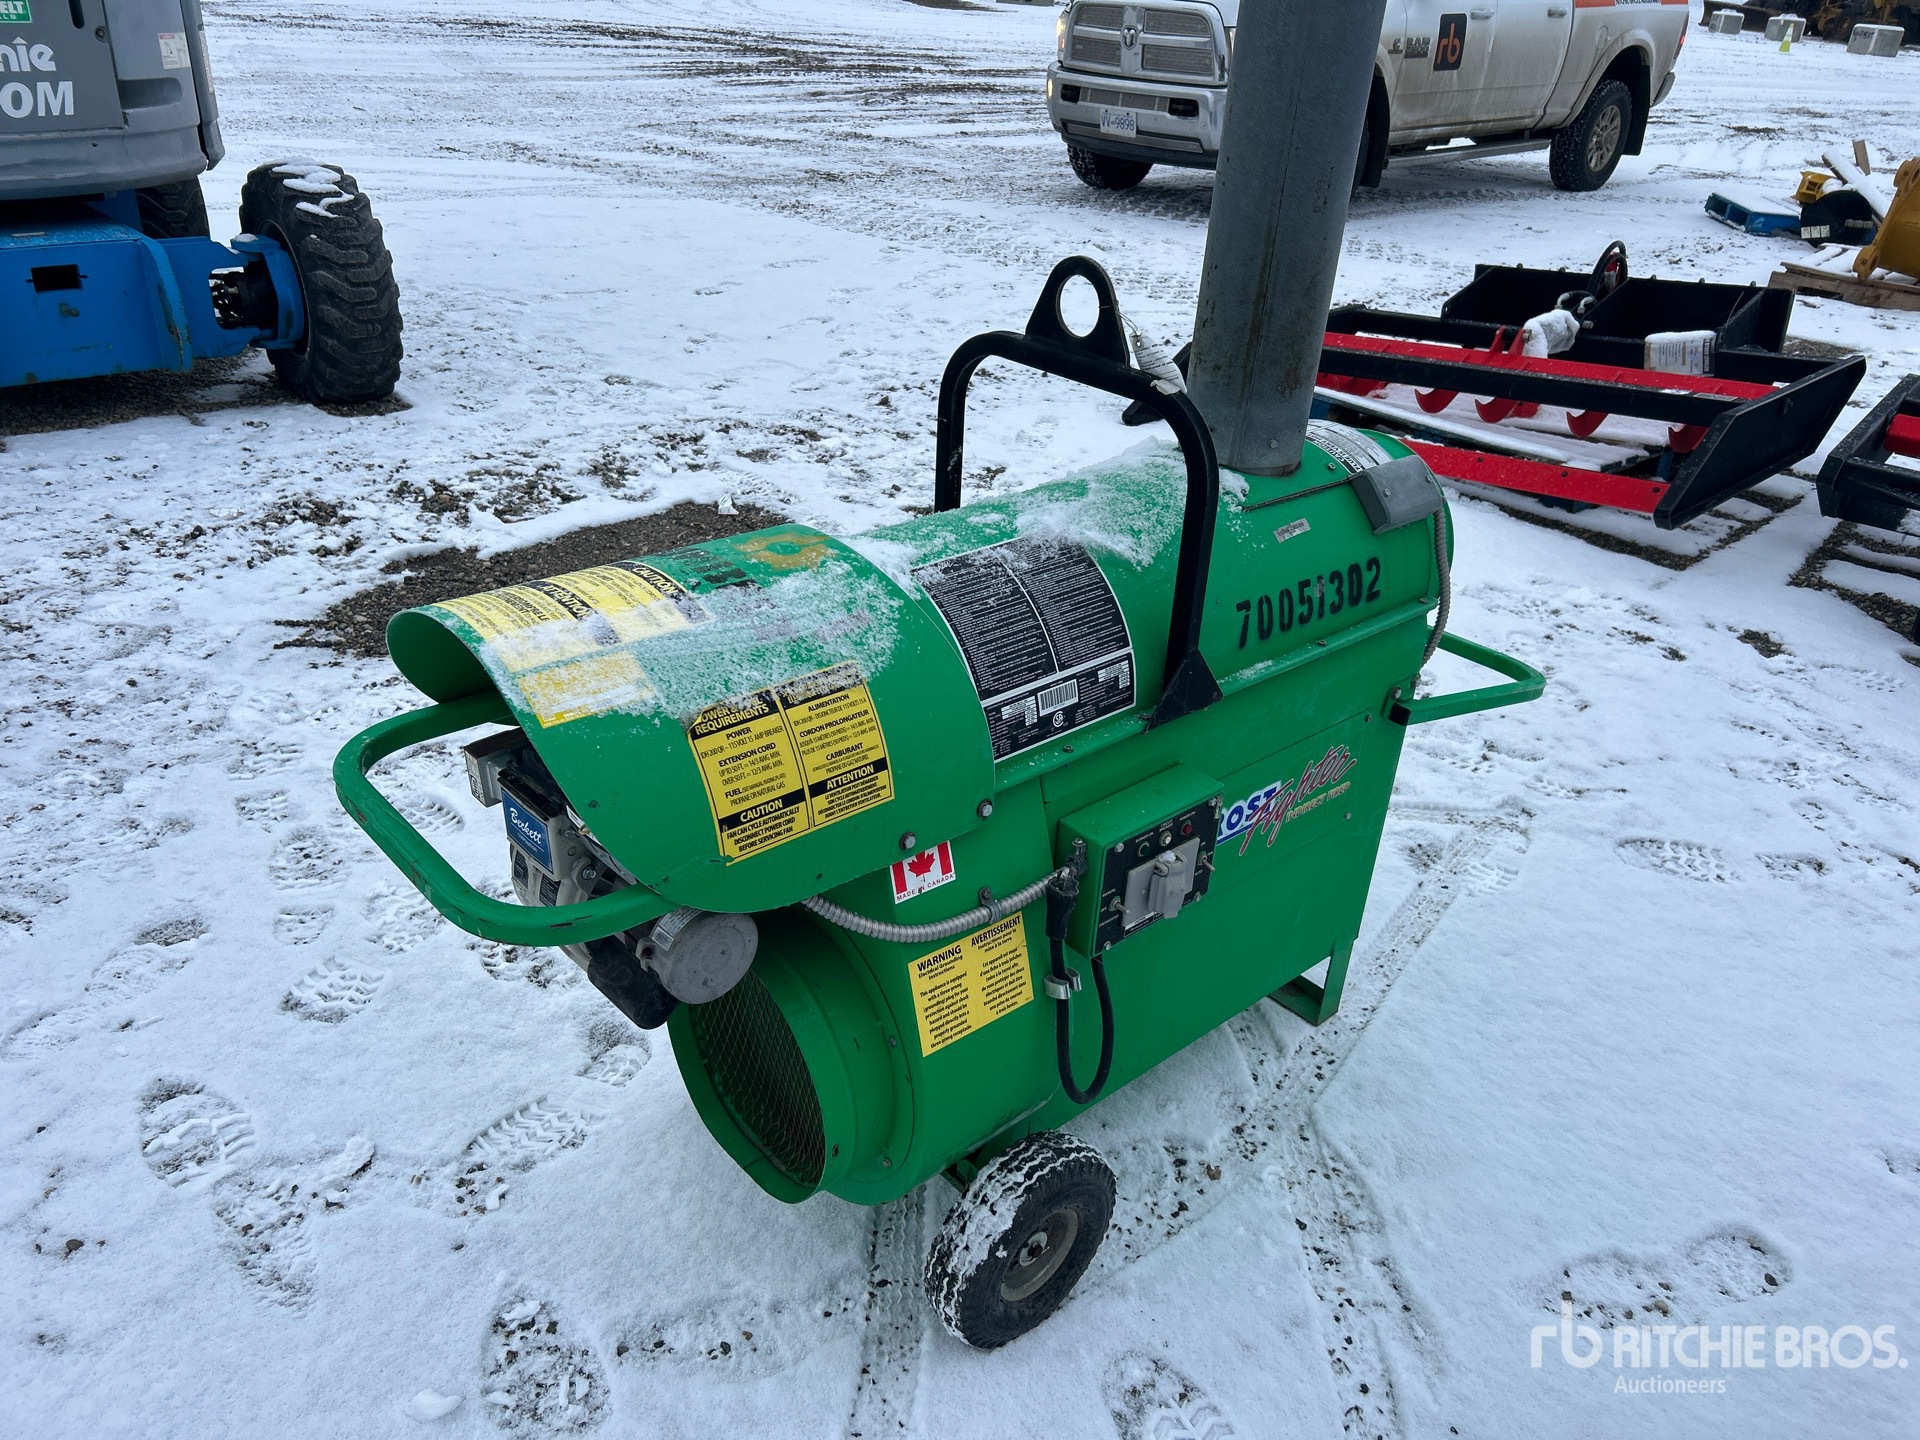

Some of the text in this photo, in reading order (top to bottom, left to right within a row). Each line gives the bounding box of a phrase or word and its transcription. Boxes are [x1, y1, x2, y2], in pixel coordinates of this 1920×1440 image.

[1436, 22, 1460, 64] rb
[0, 81, 75, 119] OM
[632, 567, 679, 595] CAUTION
[1236, 556, 1381, 650] 70051302
[701, 706, 732, 723] OWER
[807, 693, 849, 712] ALIMENTATION
[695, 703, 769, 736] REQUIREMENTS
[799, 708, 869, 738] CORDON PROLONGATEUR
[725, 726, 752, 740] POWER
[718, 742, 776, 767] EXTENSION CORD
[825, 741, 863, 761] CARBURANT
[825, 763, 874, 790] ATTENTION
[724, 787, 742, 798] FUEL
[729, 793, 751, 806] PROPANE
[756, 784, 776, 796] NATURAL
[775, 780, 785, 789] GAS
[1239, 745, 1357, 856] Fighter
[1285, 781, 1351, 822] INDIRECT FIRED
[726, 805, 800, 839] FAN CAN CYCLE AUTOMATICALLY
[739, 798, 783, 822] CAUTION
[510, 807, 542, 845] Beckett
[733, 816, 796, 845] DISCONNECT POWER CORD
[738, 825, 794, 852] BEFORE SERVICING FAN
[896, 889, 915, 901] MADE
[928, 873, 954, 888] CANADA
[970, 915, 1020, 946] AVERTISSEMENT
[977, 934, 1002, 950] Instructions
[1002, 930, 1011, 939] pour
[984, 935, 1012, 953] mise terre
[916, 943, 961, 972] WARNING
[918, 953, 963, 978] Electrical Grounding
[919, 970, 967, 997] This appliance equipped
[928, 963, 955, 980] Instructions
[927, 981, 962, 1002] with three-prong
[945, 993, 954, 1002] plug
[924, 993, 968, 1020] protection against shock
[929, 1014, 942, 1025] hazard
[949, 1004, 962, 1014] should
[928, 1021, 944, 1034] plugged
[944, 1014, 958, 1026] directly
[933, 1017, 967, 1040] properly grounded
[930, 1032, 952, 1049] three-prong
